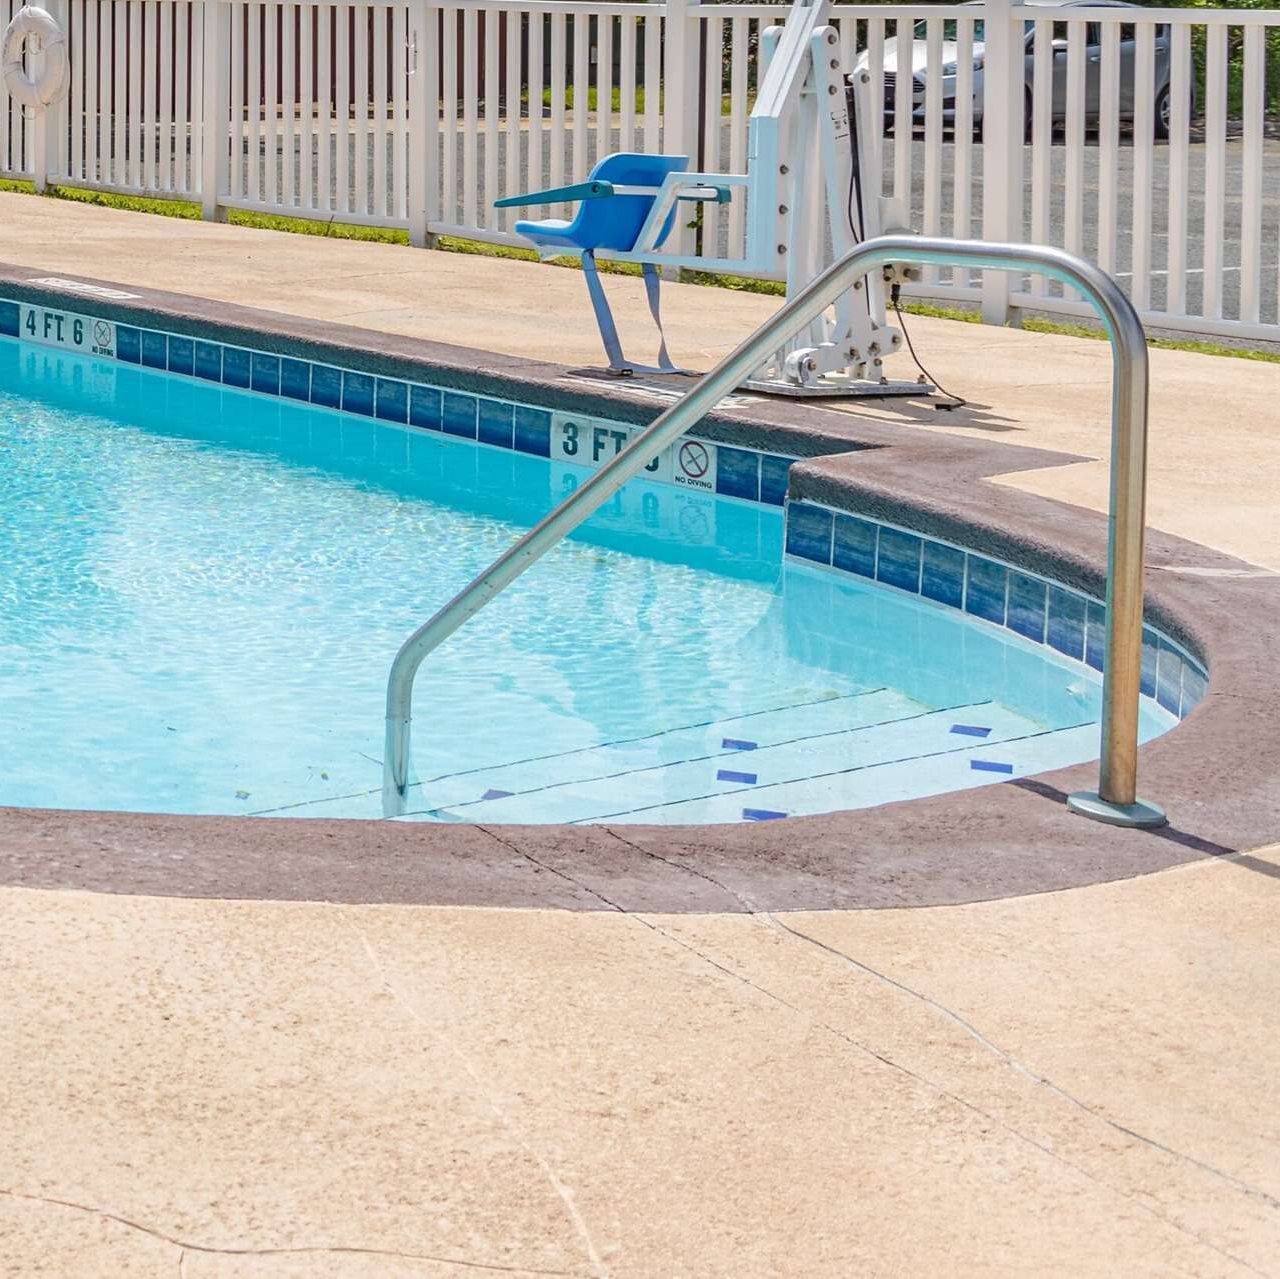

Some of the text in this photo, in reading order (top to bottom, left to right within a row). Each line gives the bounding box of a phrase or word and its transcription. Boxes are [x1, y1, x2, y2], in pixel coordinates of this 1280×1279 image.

[26, 310, 83, 345] 4 FT. 6
[562, 422, 578, 456] 3
[674, 475, 713, 489] NO DIVING
